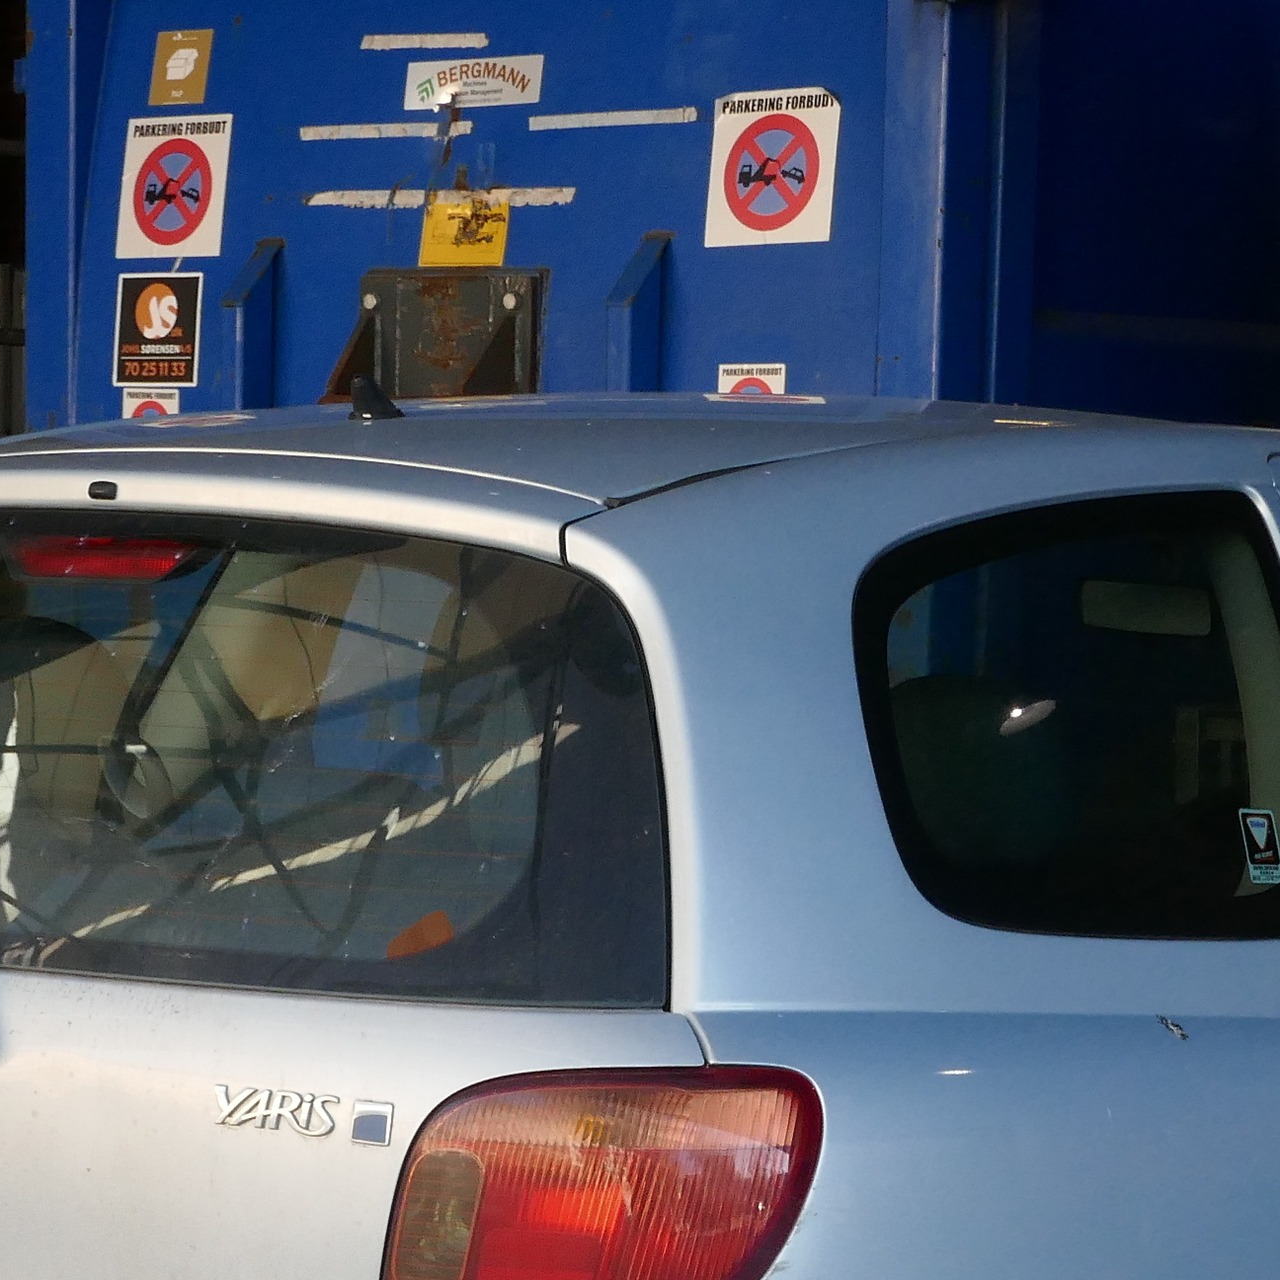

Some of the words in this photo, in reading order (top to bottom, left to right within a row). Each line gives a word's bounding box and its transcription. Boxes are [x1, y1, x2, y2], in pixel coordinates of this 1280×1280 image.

[437, 62, 531, 93] BERGMANN
[722, 97, 784, 115] PARKERING
[133, 123, 184, 138] PARKERING
[185, 121, 228, 135] FORBUDT
[140, 344, 180, 354] SØRENSEN
[125, 362, 140, 377] 70
[141, 362, 158, 377] 25
[159, 361, 169, 376] 11
[170, 361, 186, 376] 33
[722, 367, 755, 377] PARKERING
